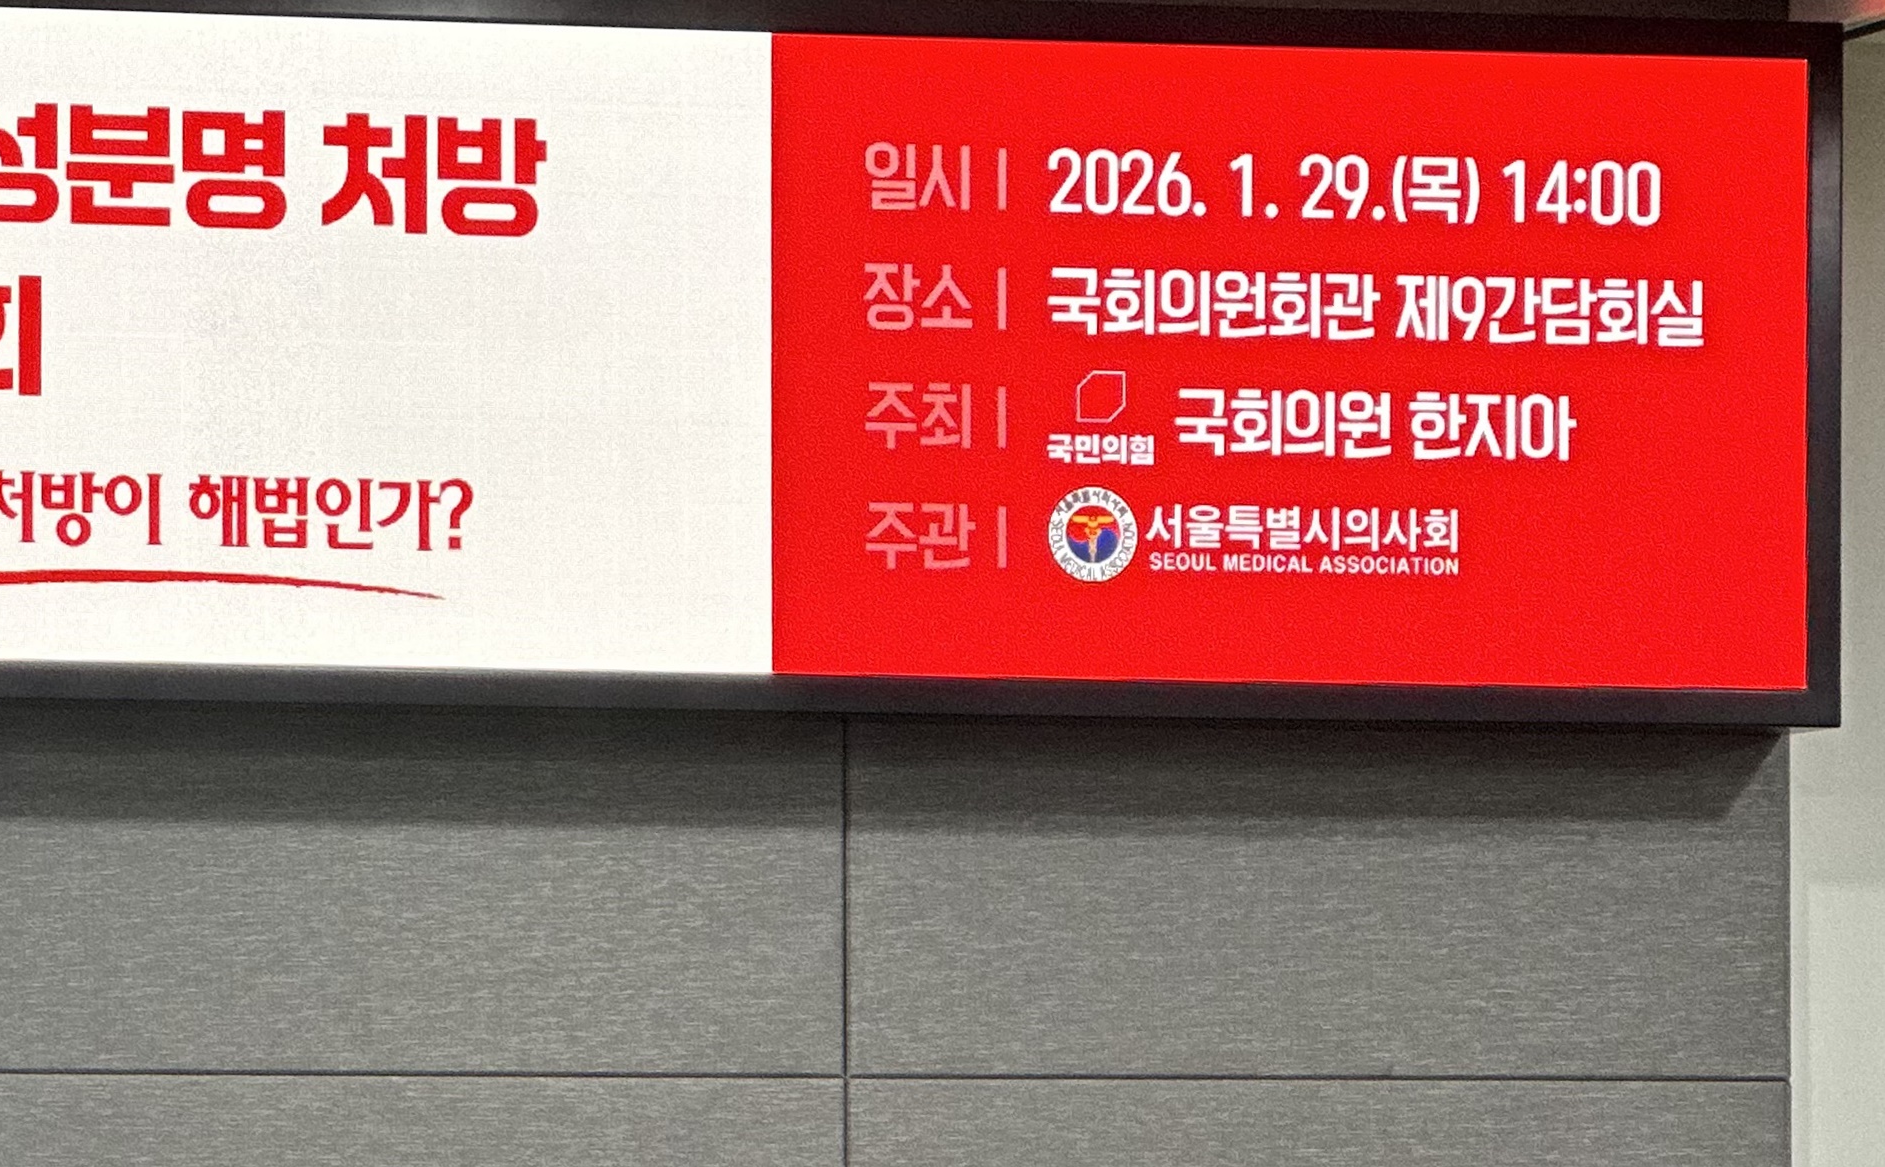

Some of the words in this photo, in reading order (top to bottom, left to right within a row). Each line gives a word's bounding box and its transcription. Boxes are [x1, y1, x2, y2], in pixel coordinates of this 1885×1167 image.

[322, 114, 547, 238] 처방
[863, 141, 971, 211] 일시
[1047, 147, 1207, 217] 2026.
[1228, 153, 1279, 219] 1.
[1299, 153, 1480, 224] 29.(목)
[1501, 159, 1661, 227] 14:00
[862, 262, 974, 331] 장소
[1047, 267, 1381, 341] 국회의원회관
[1395, 274, 1704, 347] 제9간담회실
[864, 381, 972, 450] 주최
[1174, 388, 1392, 459] 국회의원
[1409, 391, 1578, 462] 한지아
[1046, 433, 1155, 466] 국민의힘
[189, 475, 474, 551] 해법인가?
[864, 502, 977, 570] 주관
[1145, 503, 1459, 554] 서울특별시의사회
[1149, 551, 1217, 572] SEOUL
[1222, 553, 1314, 574] MEDICAL
[1319, 555, 1460, 576] ASSOCIATION
